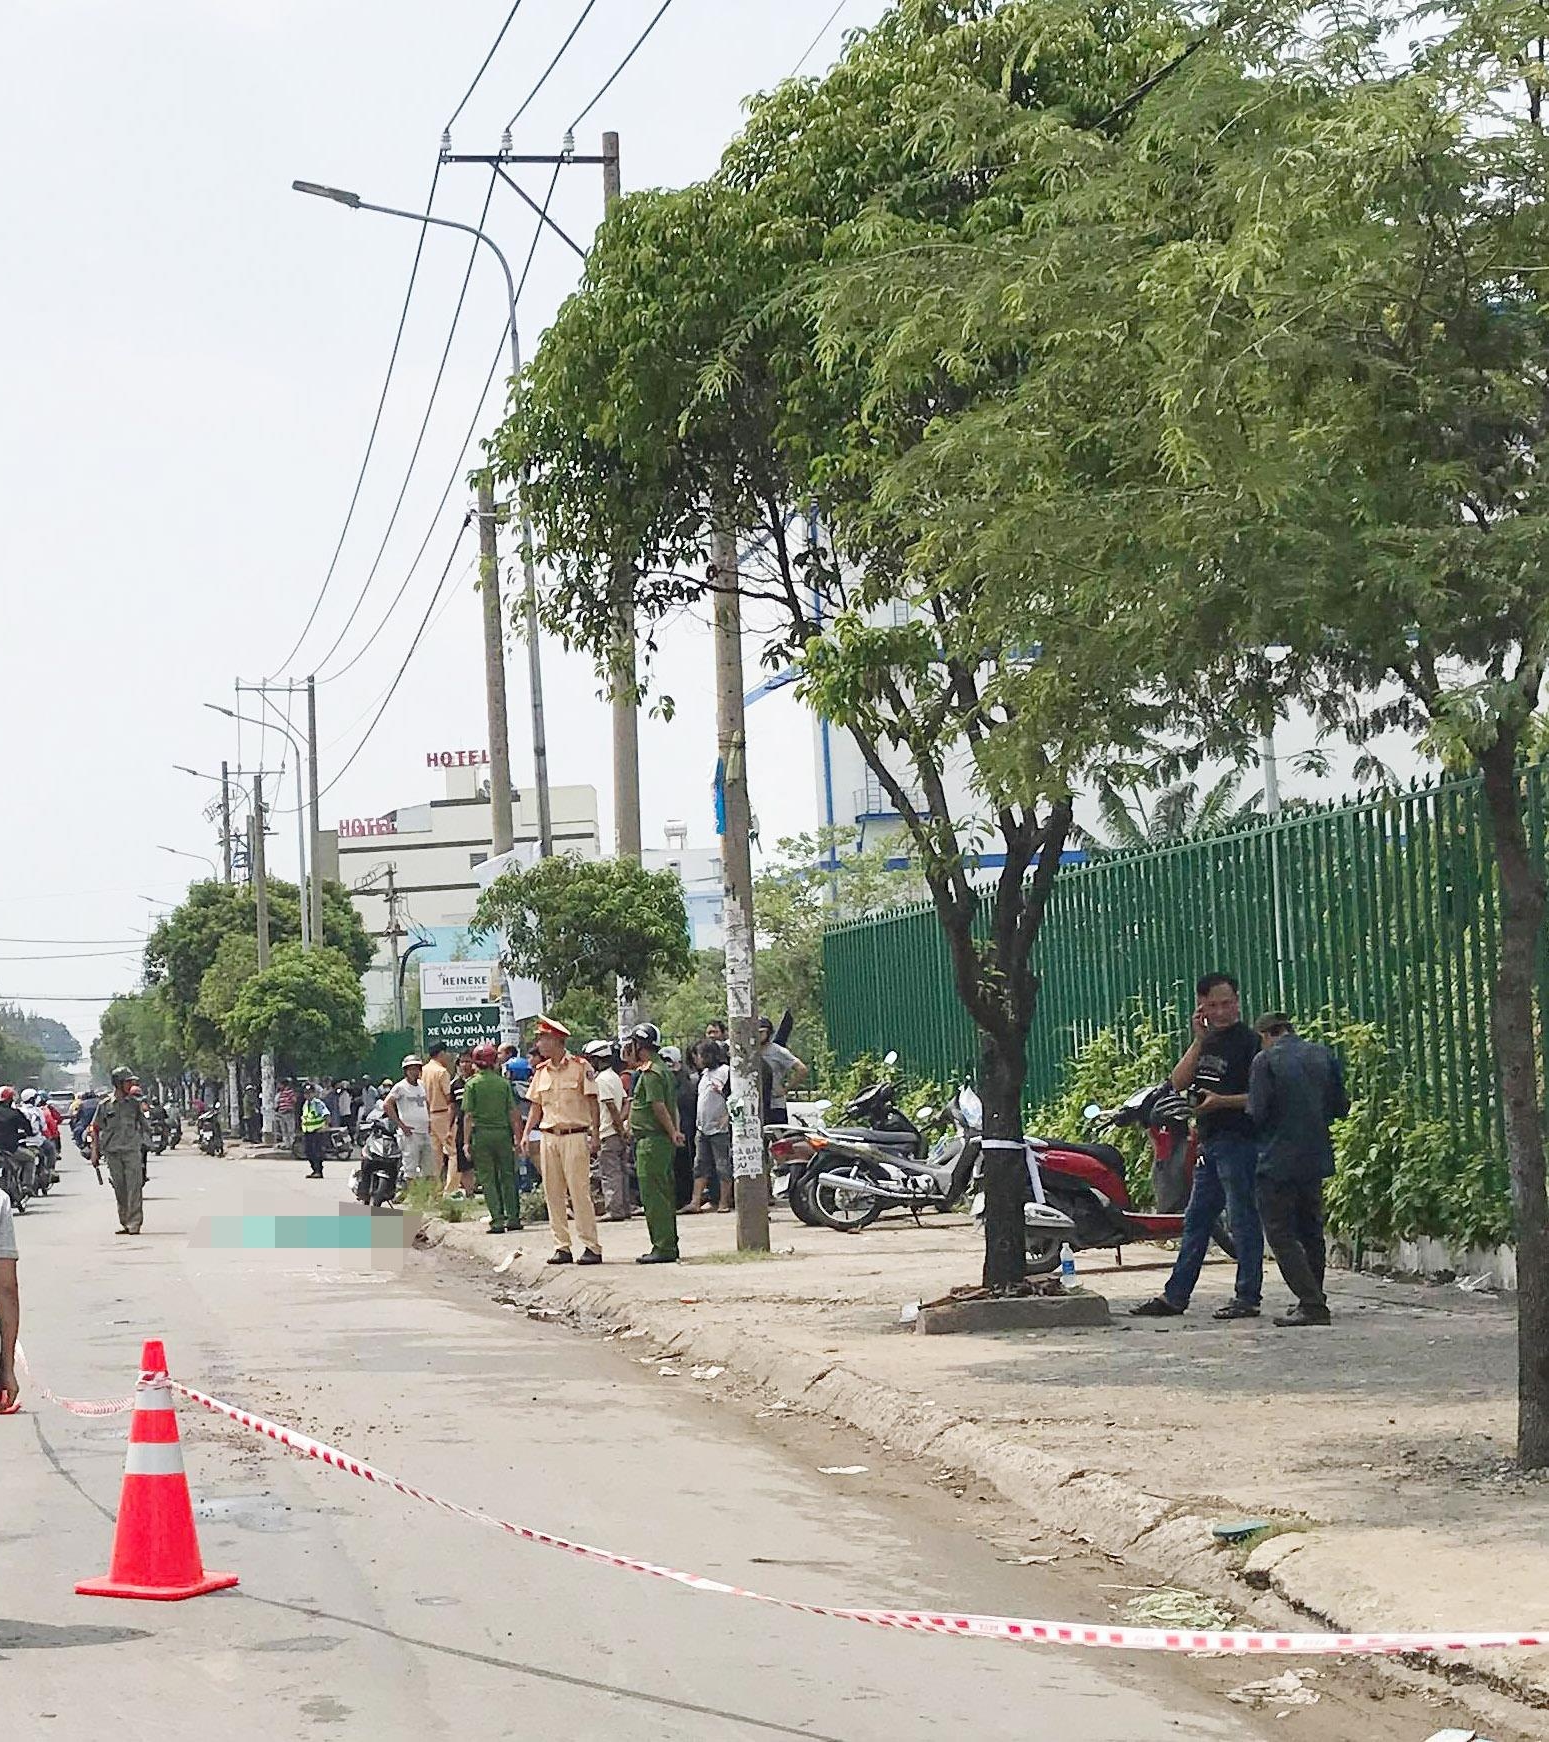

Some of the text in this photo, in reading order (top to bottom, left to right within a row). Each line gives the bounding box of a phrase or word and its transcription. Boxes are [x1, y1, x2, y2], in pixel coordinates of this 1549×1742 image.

[426, 750, 491, 768] HOTEL
[339, 817, 398, 837] HOTEL
[442, 976, 488, 986] HEINEKE
[427, 1027, 440, 1036] XE
[441, 1024, 462, 1035] VÀO
[463, 1024, 485, 1034] NHÀ
